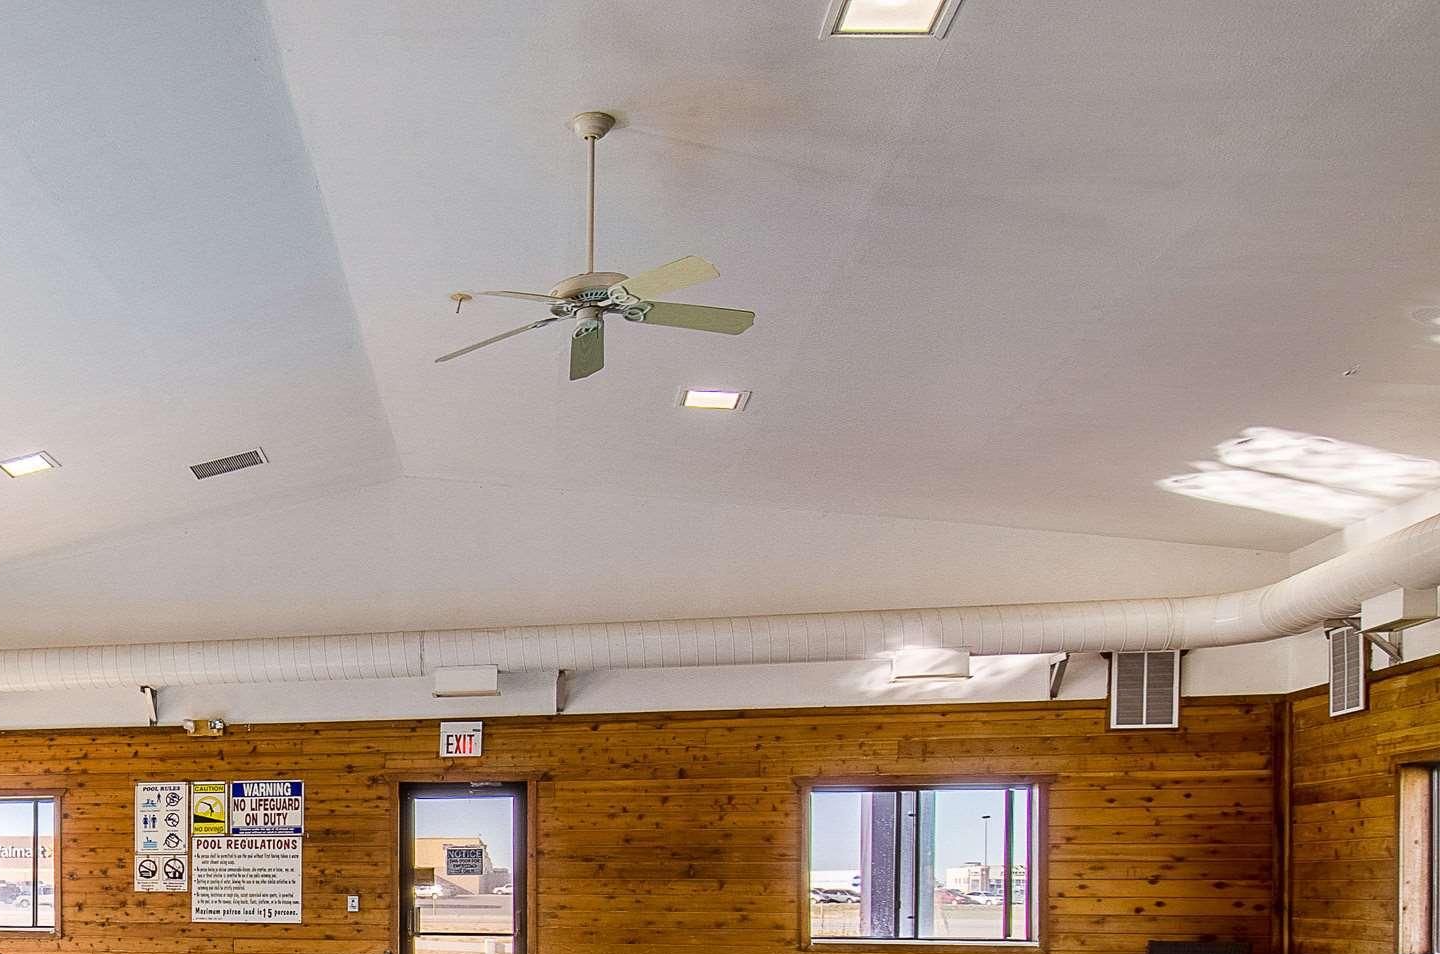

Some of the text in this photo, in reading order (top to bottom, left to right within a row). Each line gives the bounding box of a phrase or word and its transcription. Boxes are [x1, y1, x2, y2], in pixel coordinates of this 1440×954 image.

[446, 734, 475, 754] EXIT
[194, 784, 224, 792] CAUTION
[242, 782, 292, 797] WARNING
[233, 798, 300, 812] NO LIFEGUARD
[245, 812, 288, 826] ON DUTY
[196, 838, 298, 850] POOL REGULATIONS
[448, 850, 481, 858] NOTICE
[195, 907, 221, 915] Maximum
[242, 907, 255, 915] load
[263, 909, 272, 918] 15
